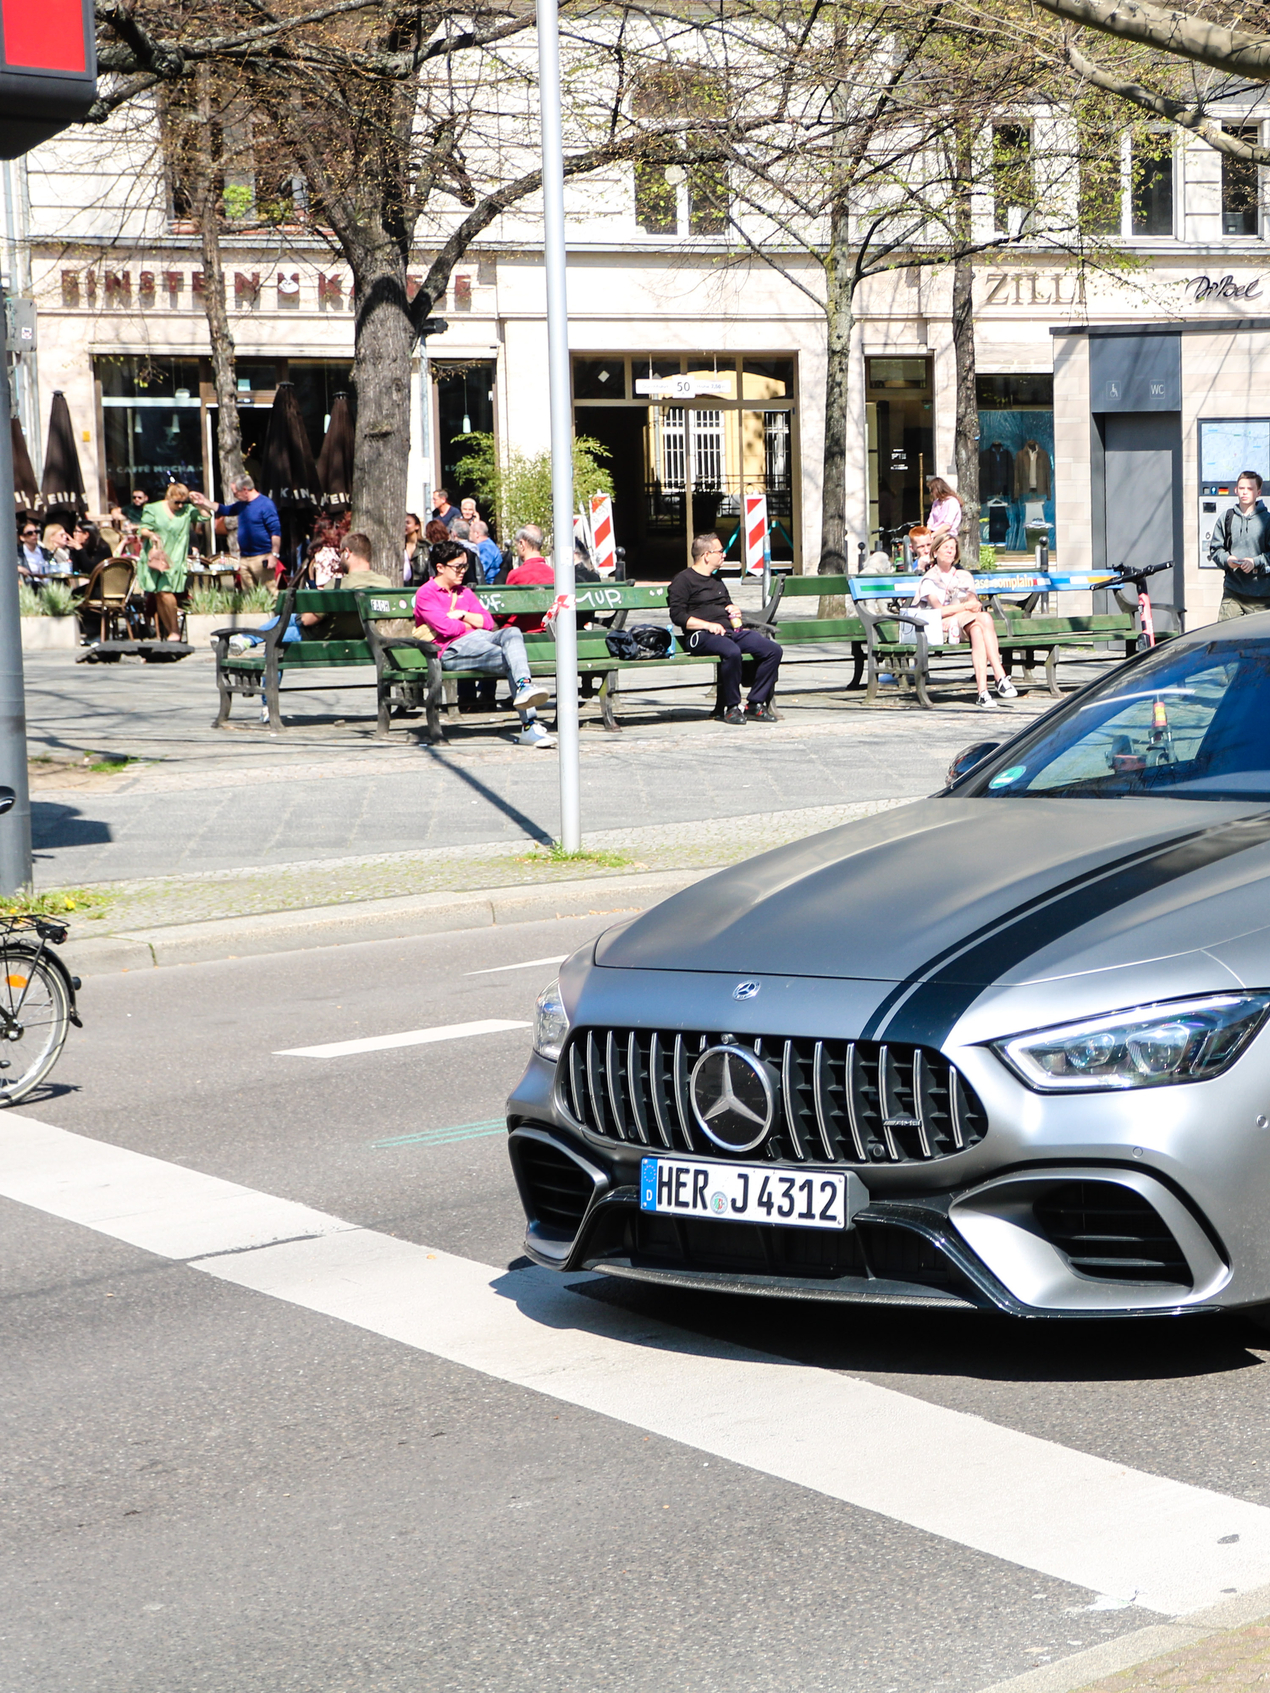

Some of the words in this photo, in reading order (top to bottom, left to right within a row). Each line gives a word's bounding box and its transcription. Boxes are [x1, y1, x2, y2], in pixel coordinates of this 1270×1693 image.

[676, 381, 691, 392] 50
[1150, 384, 1165, 396] WC
[992, 573, 1034, 591] complain
[646, 1189, 653, 1201] D
[657, 1165, 709, 1210] HER
[757, 1175, 838, 1222] 4312
